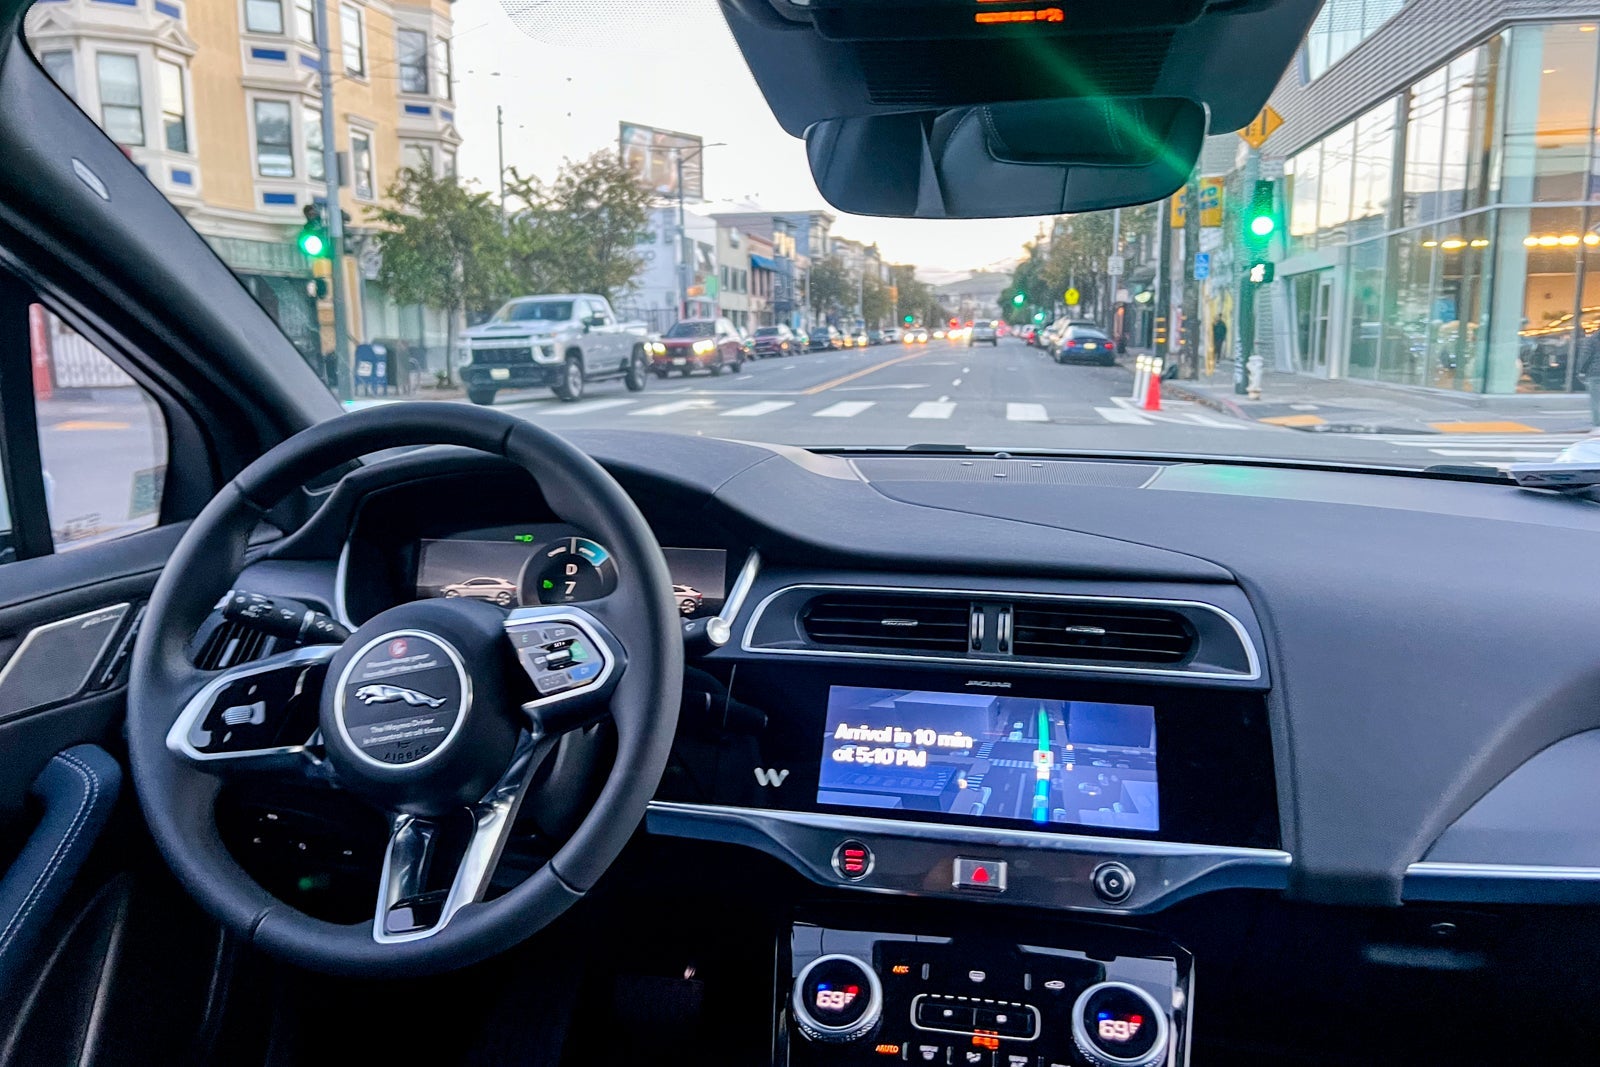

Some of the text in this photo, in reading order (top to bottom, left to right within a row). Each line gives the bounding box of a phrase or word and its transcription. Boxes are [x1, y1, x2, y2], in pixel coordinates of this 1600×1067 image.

[566, 563, 578, 575] D
[565, 581, 576, 594] 7
[964, 680, 1012, 689] JAGUAR
[834, 723, 973, 749] Arrival in 10 min
[384, 745, 430, 761] AIRBAG
[832, 747, 927, 768] at 5:10 PM
